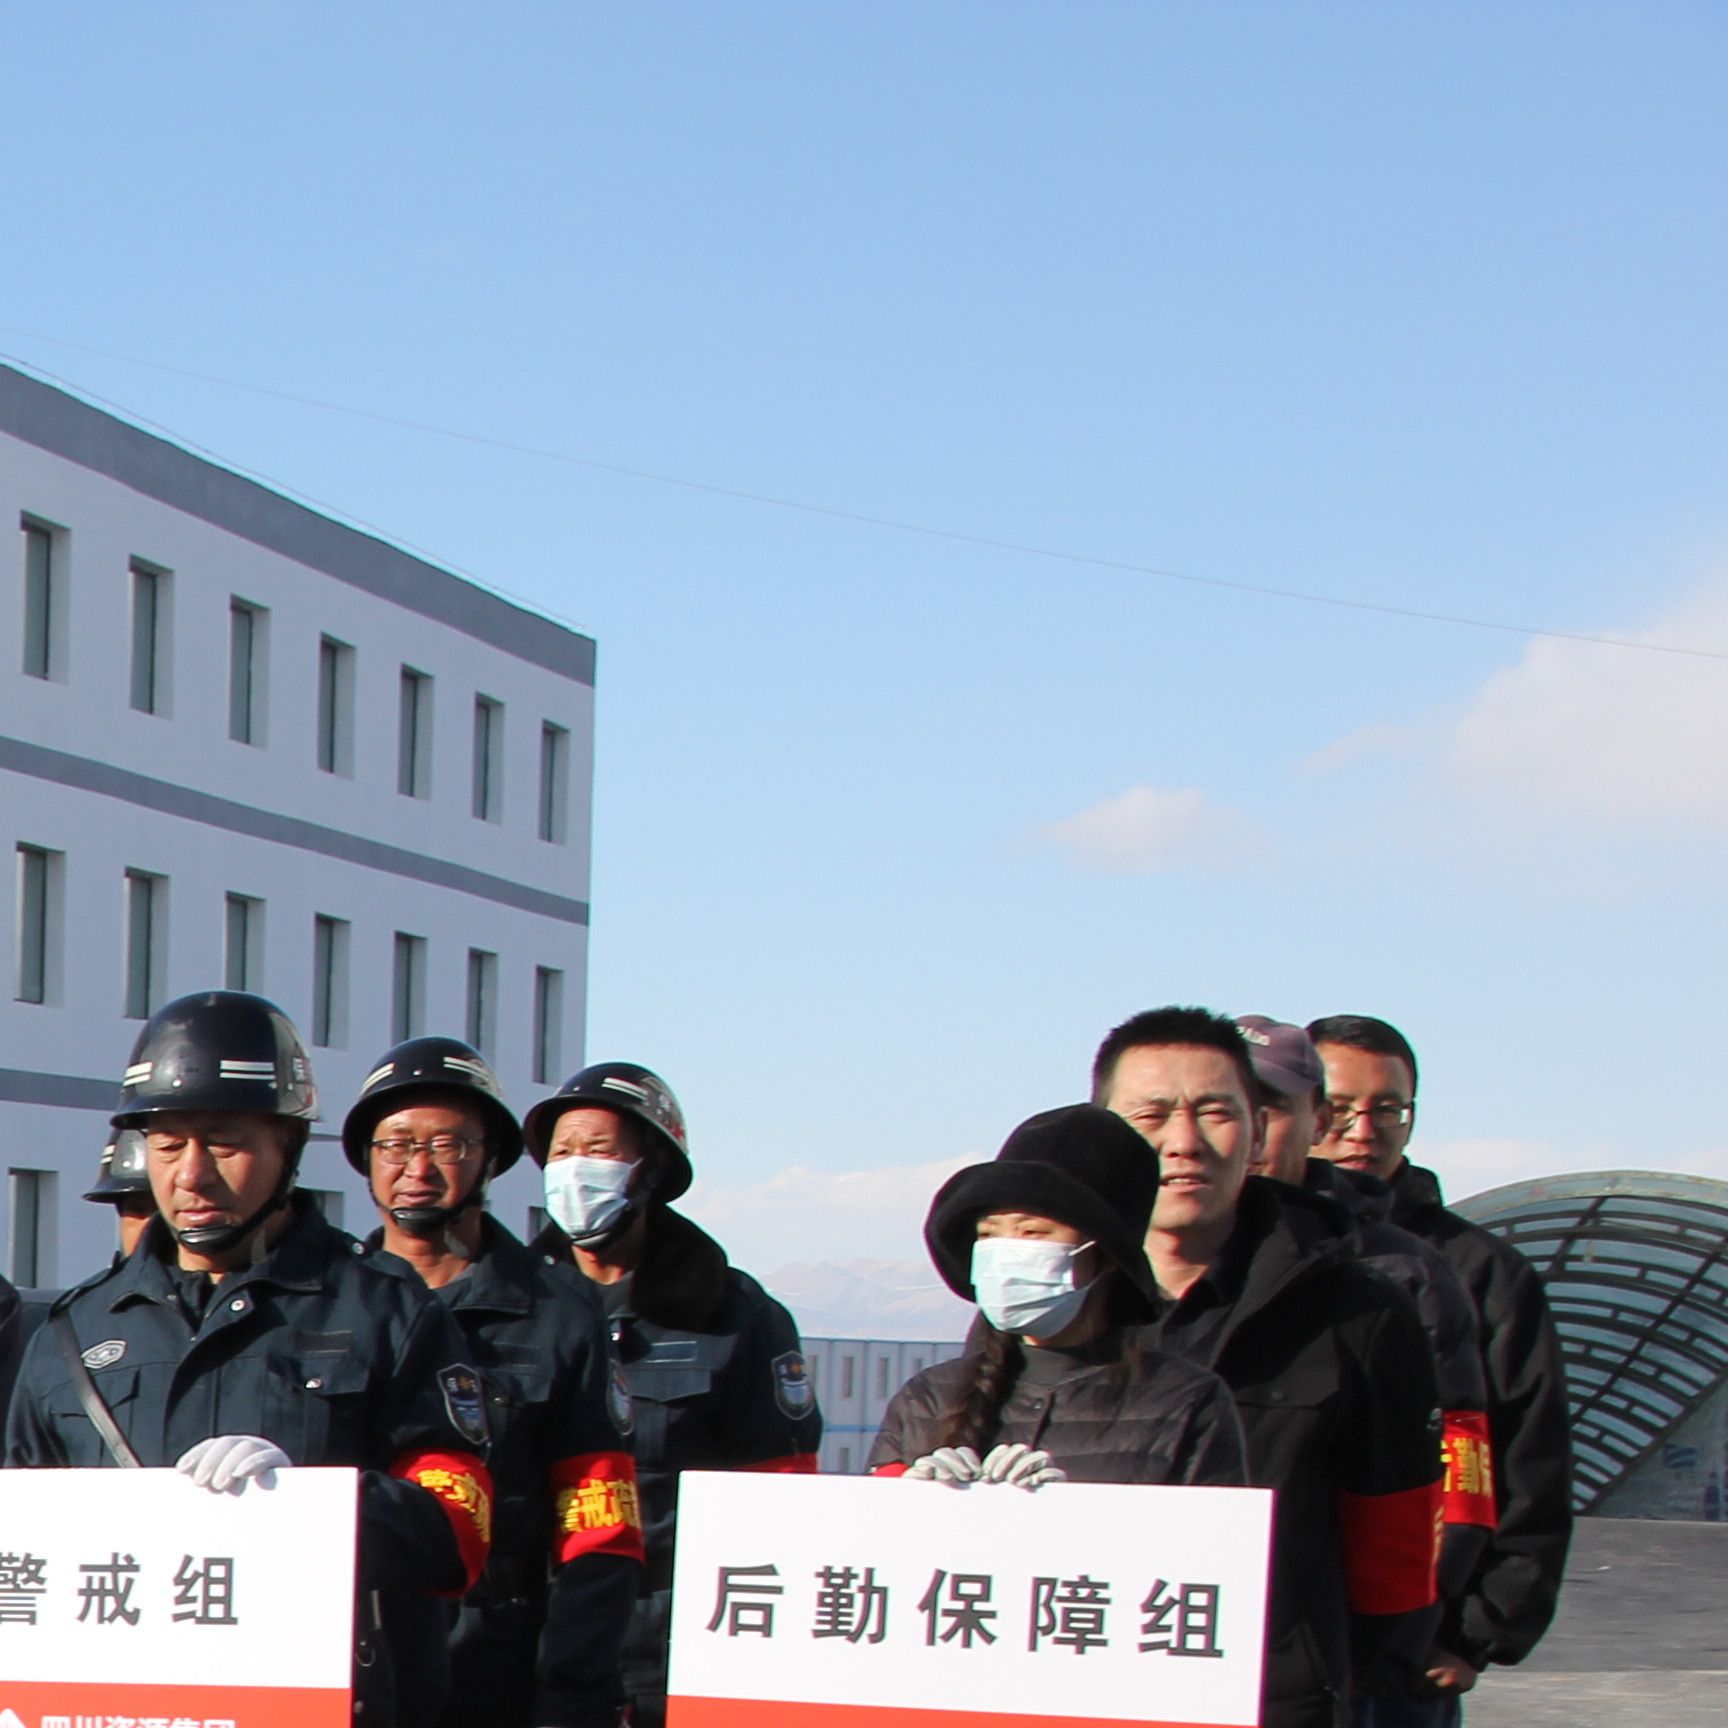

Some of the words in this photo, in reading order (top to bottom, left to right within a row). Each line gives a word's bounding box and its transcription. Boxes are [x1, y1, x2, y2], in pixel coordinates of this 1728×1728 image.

[705, 1563, 1225, 1659] 后勤保障组
